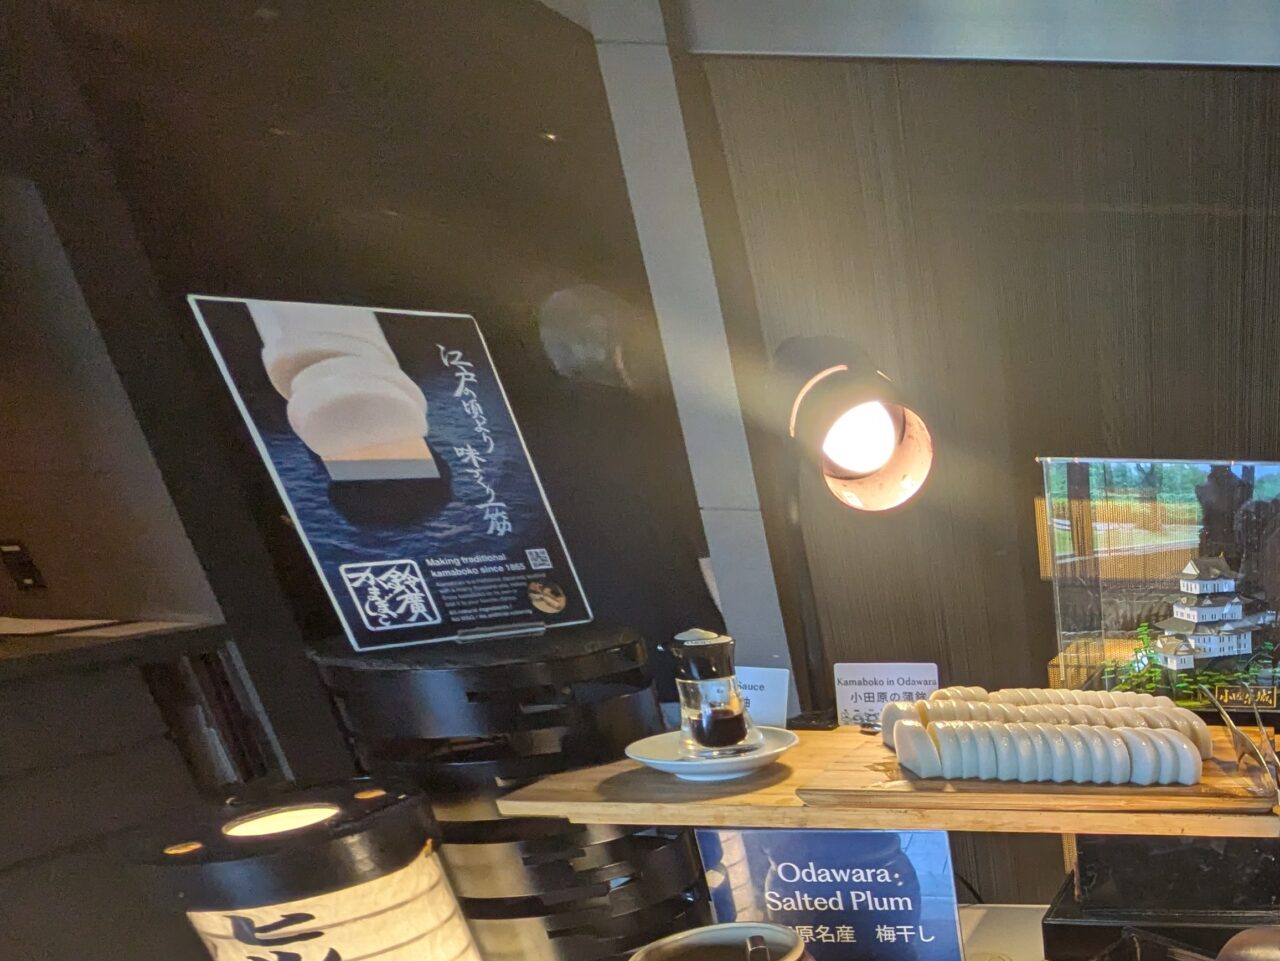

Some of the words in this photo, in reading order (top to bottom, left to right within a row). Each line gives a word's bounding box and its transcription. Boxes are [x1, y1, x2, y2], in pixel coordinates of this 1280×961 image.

[425, 556, 461, 567] Making
[462, 552, 507, 565] traditional
[430, 567, 480, 577] kamaboko
[480, 564, 504, 574] since
[837, 677, 885, 686] Kamaboko
[886, 677, 895, 686] in
[896, 676, 937, 686] Odawara
[777, 861, 891, 884] Odawara
[765, 890, 844, 912] Salted
[849, 891, 914, 912] Plum
[875, 925, 936, 944] 梅干し
